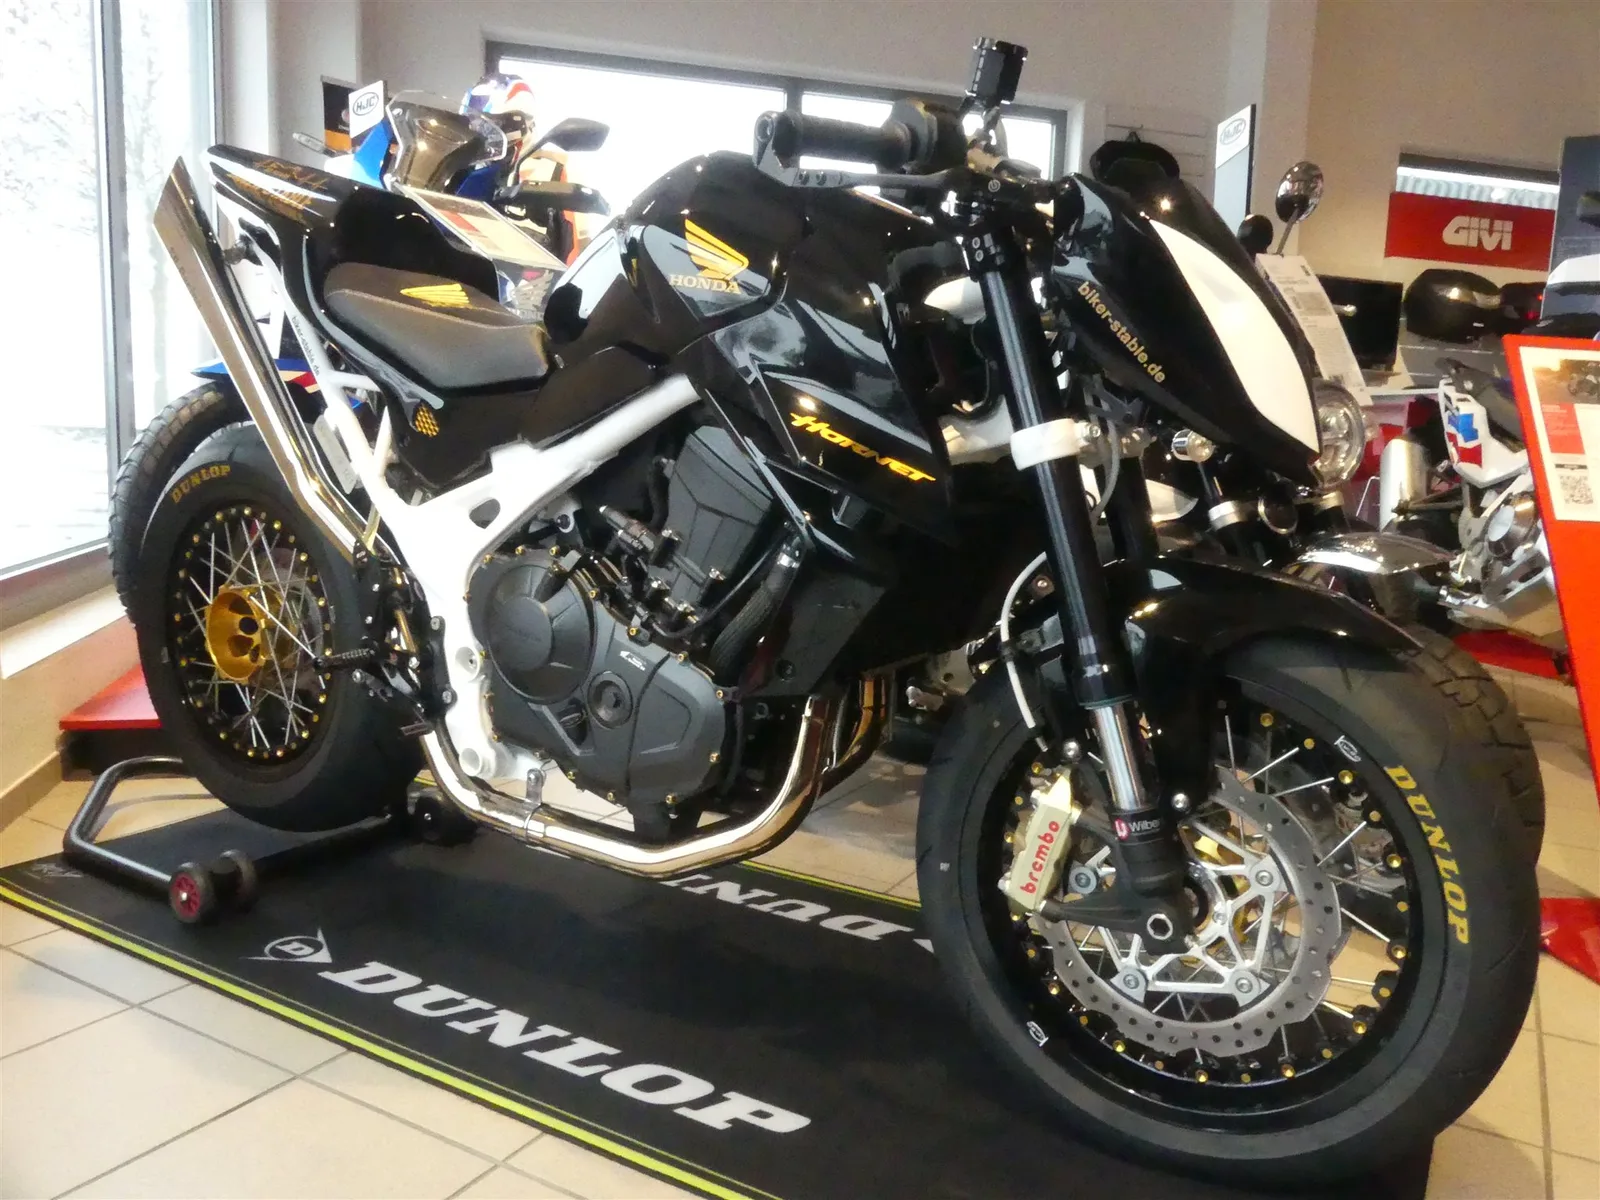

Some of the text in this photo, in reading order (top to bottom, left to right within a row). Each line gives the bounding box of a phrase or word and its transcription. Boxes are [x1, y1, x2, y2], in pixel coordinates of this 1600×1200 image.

[355, 95, 377, 112] HJC
[1442, 215, 1514, 251] GIVI
[669, 273, 742, 295] HONDA
[1078, 281, 1165, 383] biker-stable.de
[172, 464, 231, 503] DUNLOP
[1129, 819, 1160, 832] Wilbe
[1020, 820, 1060, 894] brembo
[1384, 765, 1470, 944] DUNLOP
[660, 874, 914, 941] DUN
[317, 961, 812, 1133] DUNLOP
